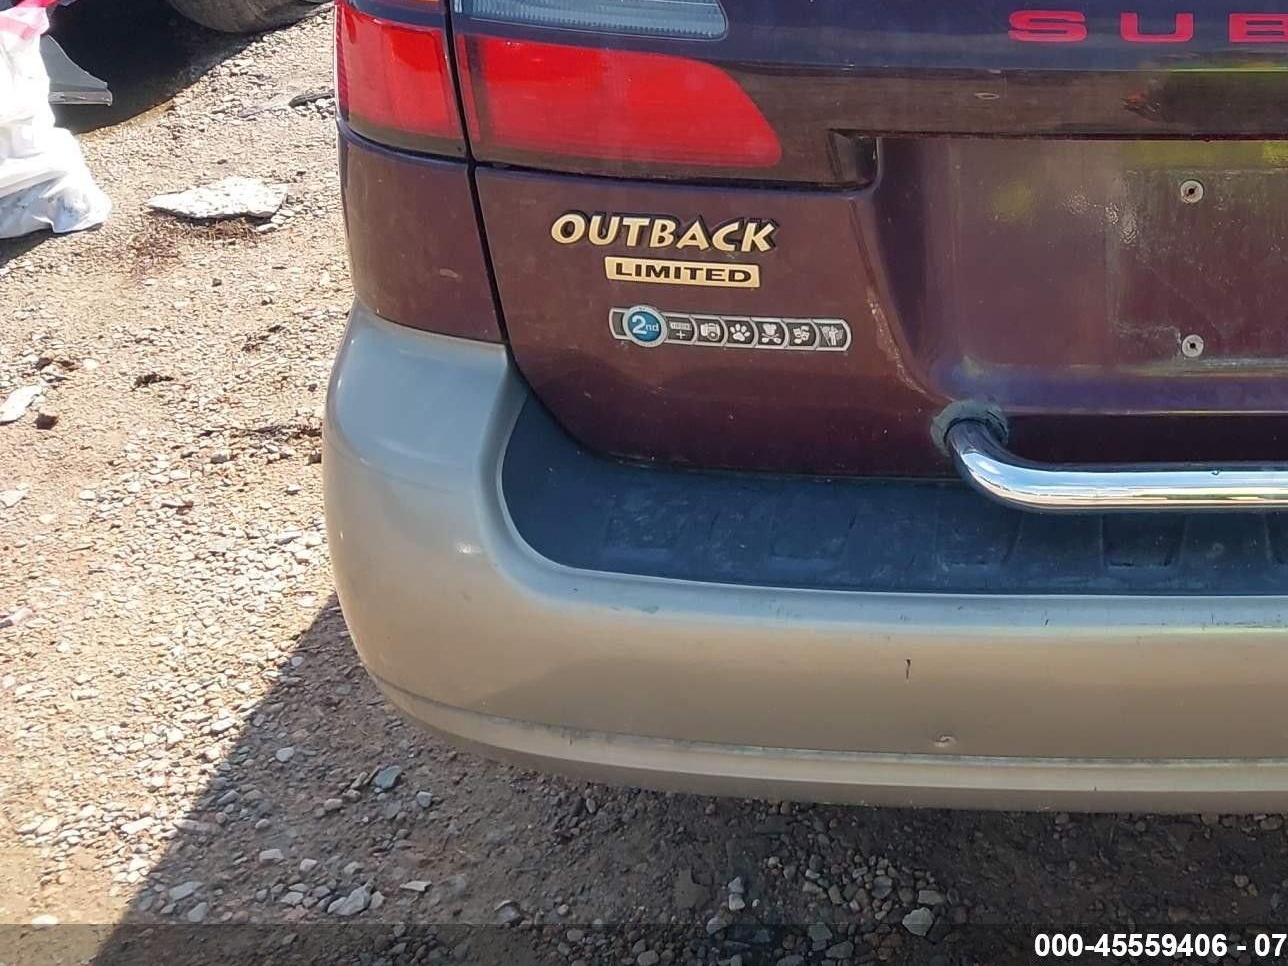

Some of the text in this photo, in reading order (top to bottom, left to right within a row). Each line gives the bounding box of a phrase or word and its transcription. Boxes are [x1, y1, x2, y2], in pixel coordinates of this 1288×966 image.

[551, 212, 776, 252] OUTBACK
[615, 262, 752, 283] LIMITED
[631, 315, 660, 335] 2nd
